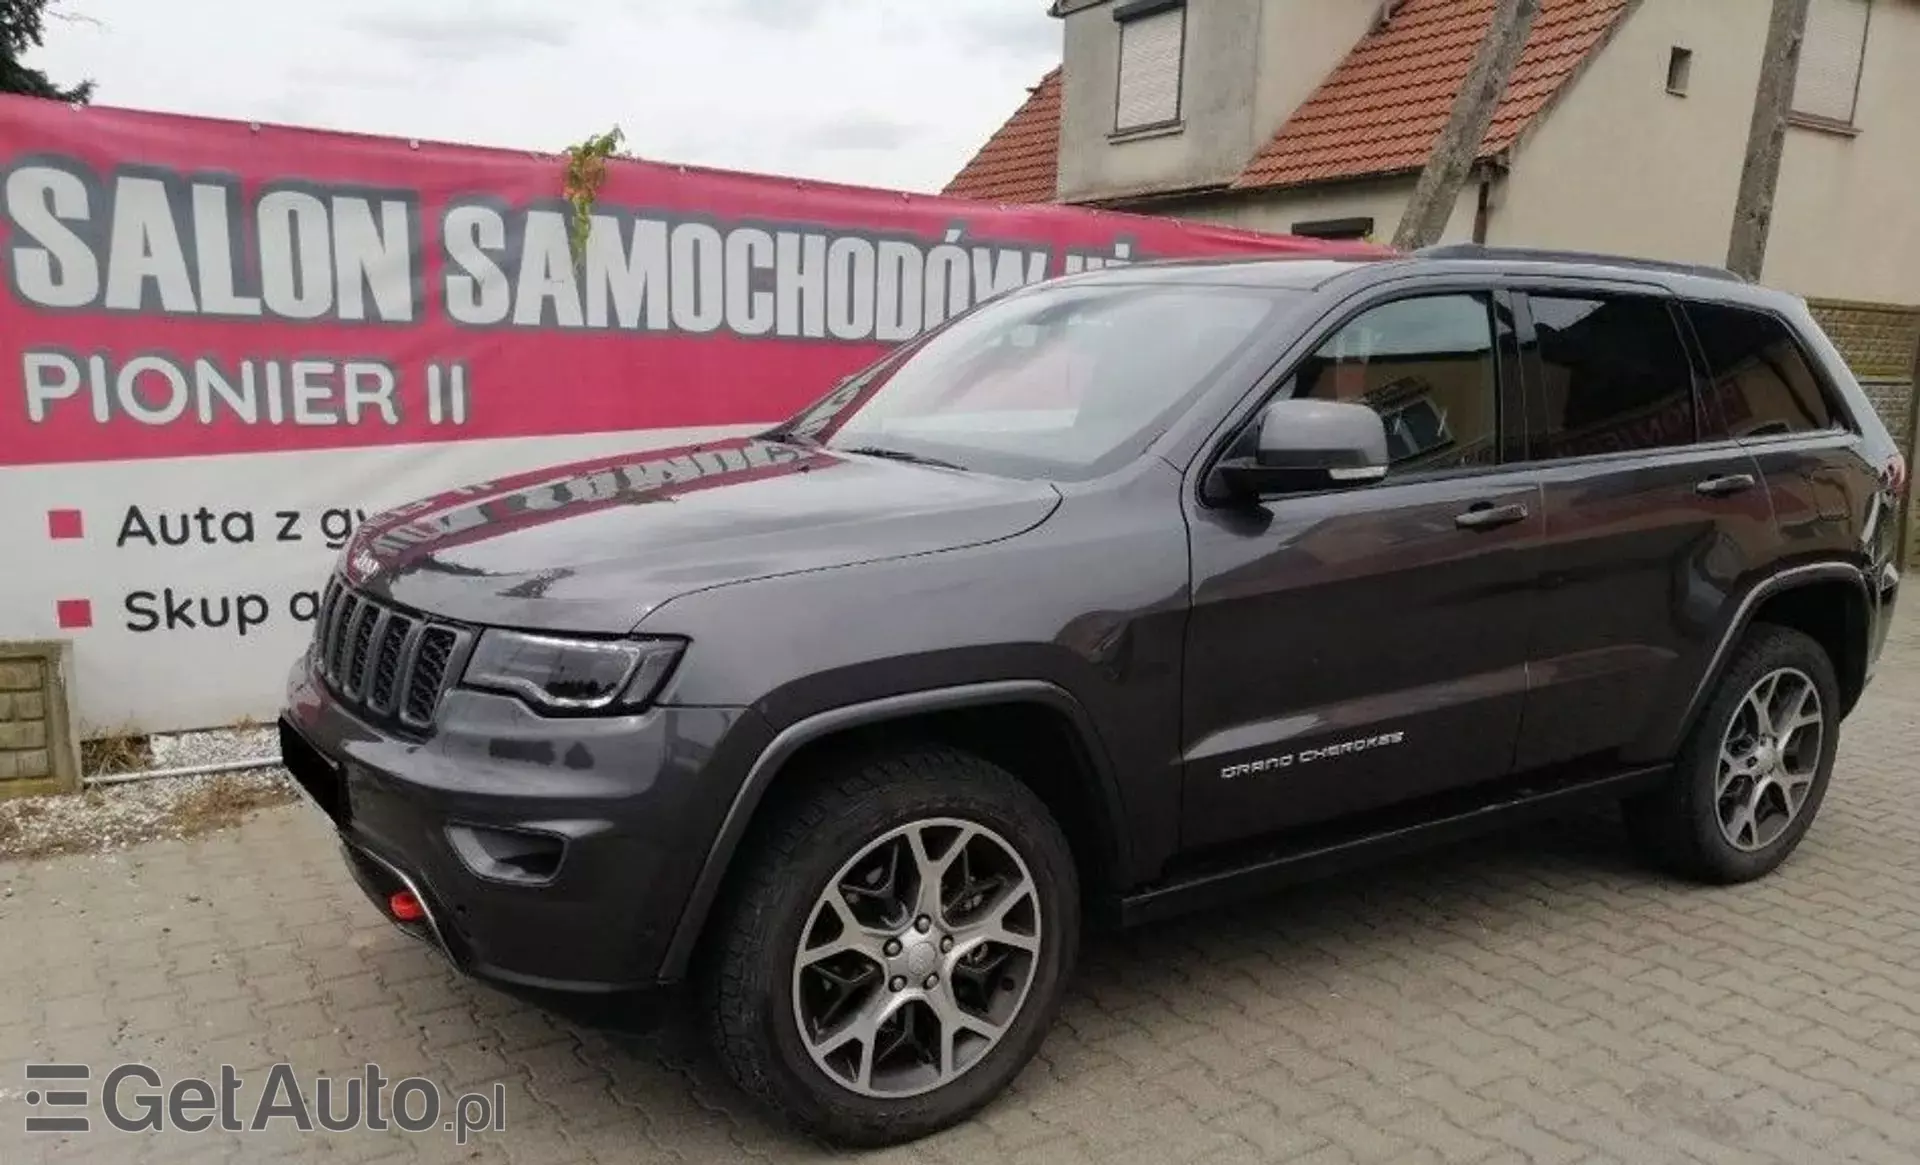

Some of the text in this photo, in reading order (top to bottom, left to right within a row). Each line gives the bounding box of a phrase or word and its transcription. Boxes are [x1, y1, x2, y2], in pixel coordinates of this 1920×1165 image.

[6, 165, 413, 322] SALON
[23, 352, 466, 424] PIONIER II
[116, 503, 366, 550] Auta z g
[124, 587, 270, 635] Skup
[1220, 731, 1405, 779] GRAND CHEROKEE
